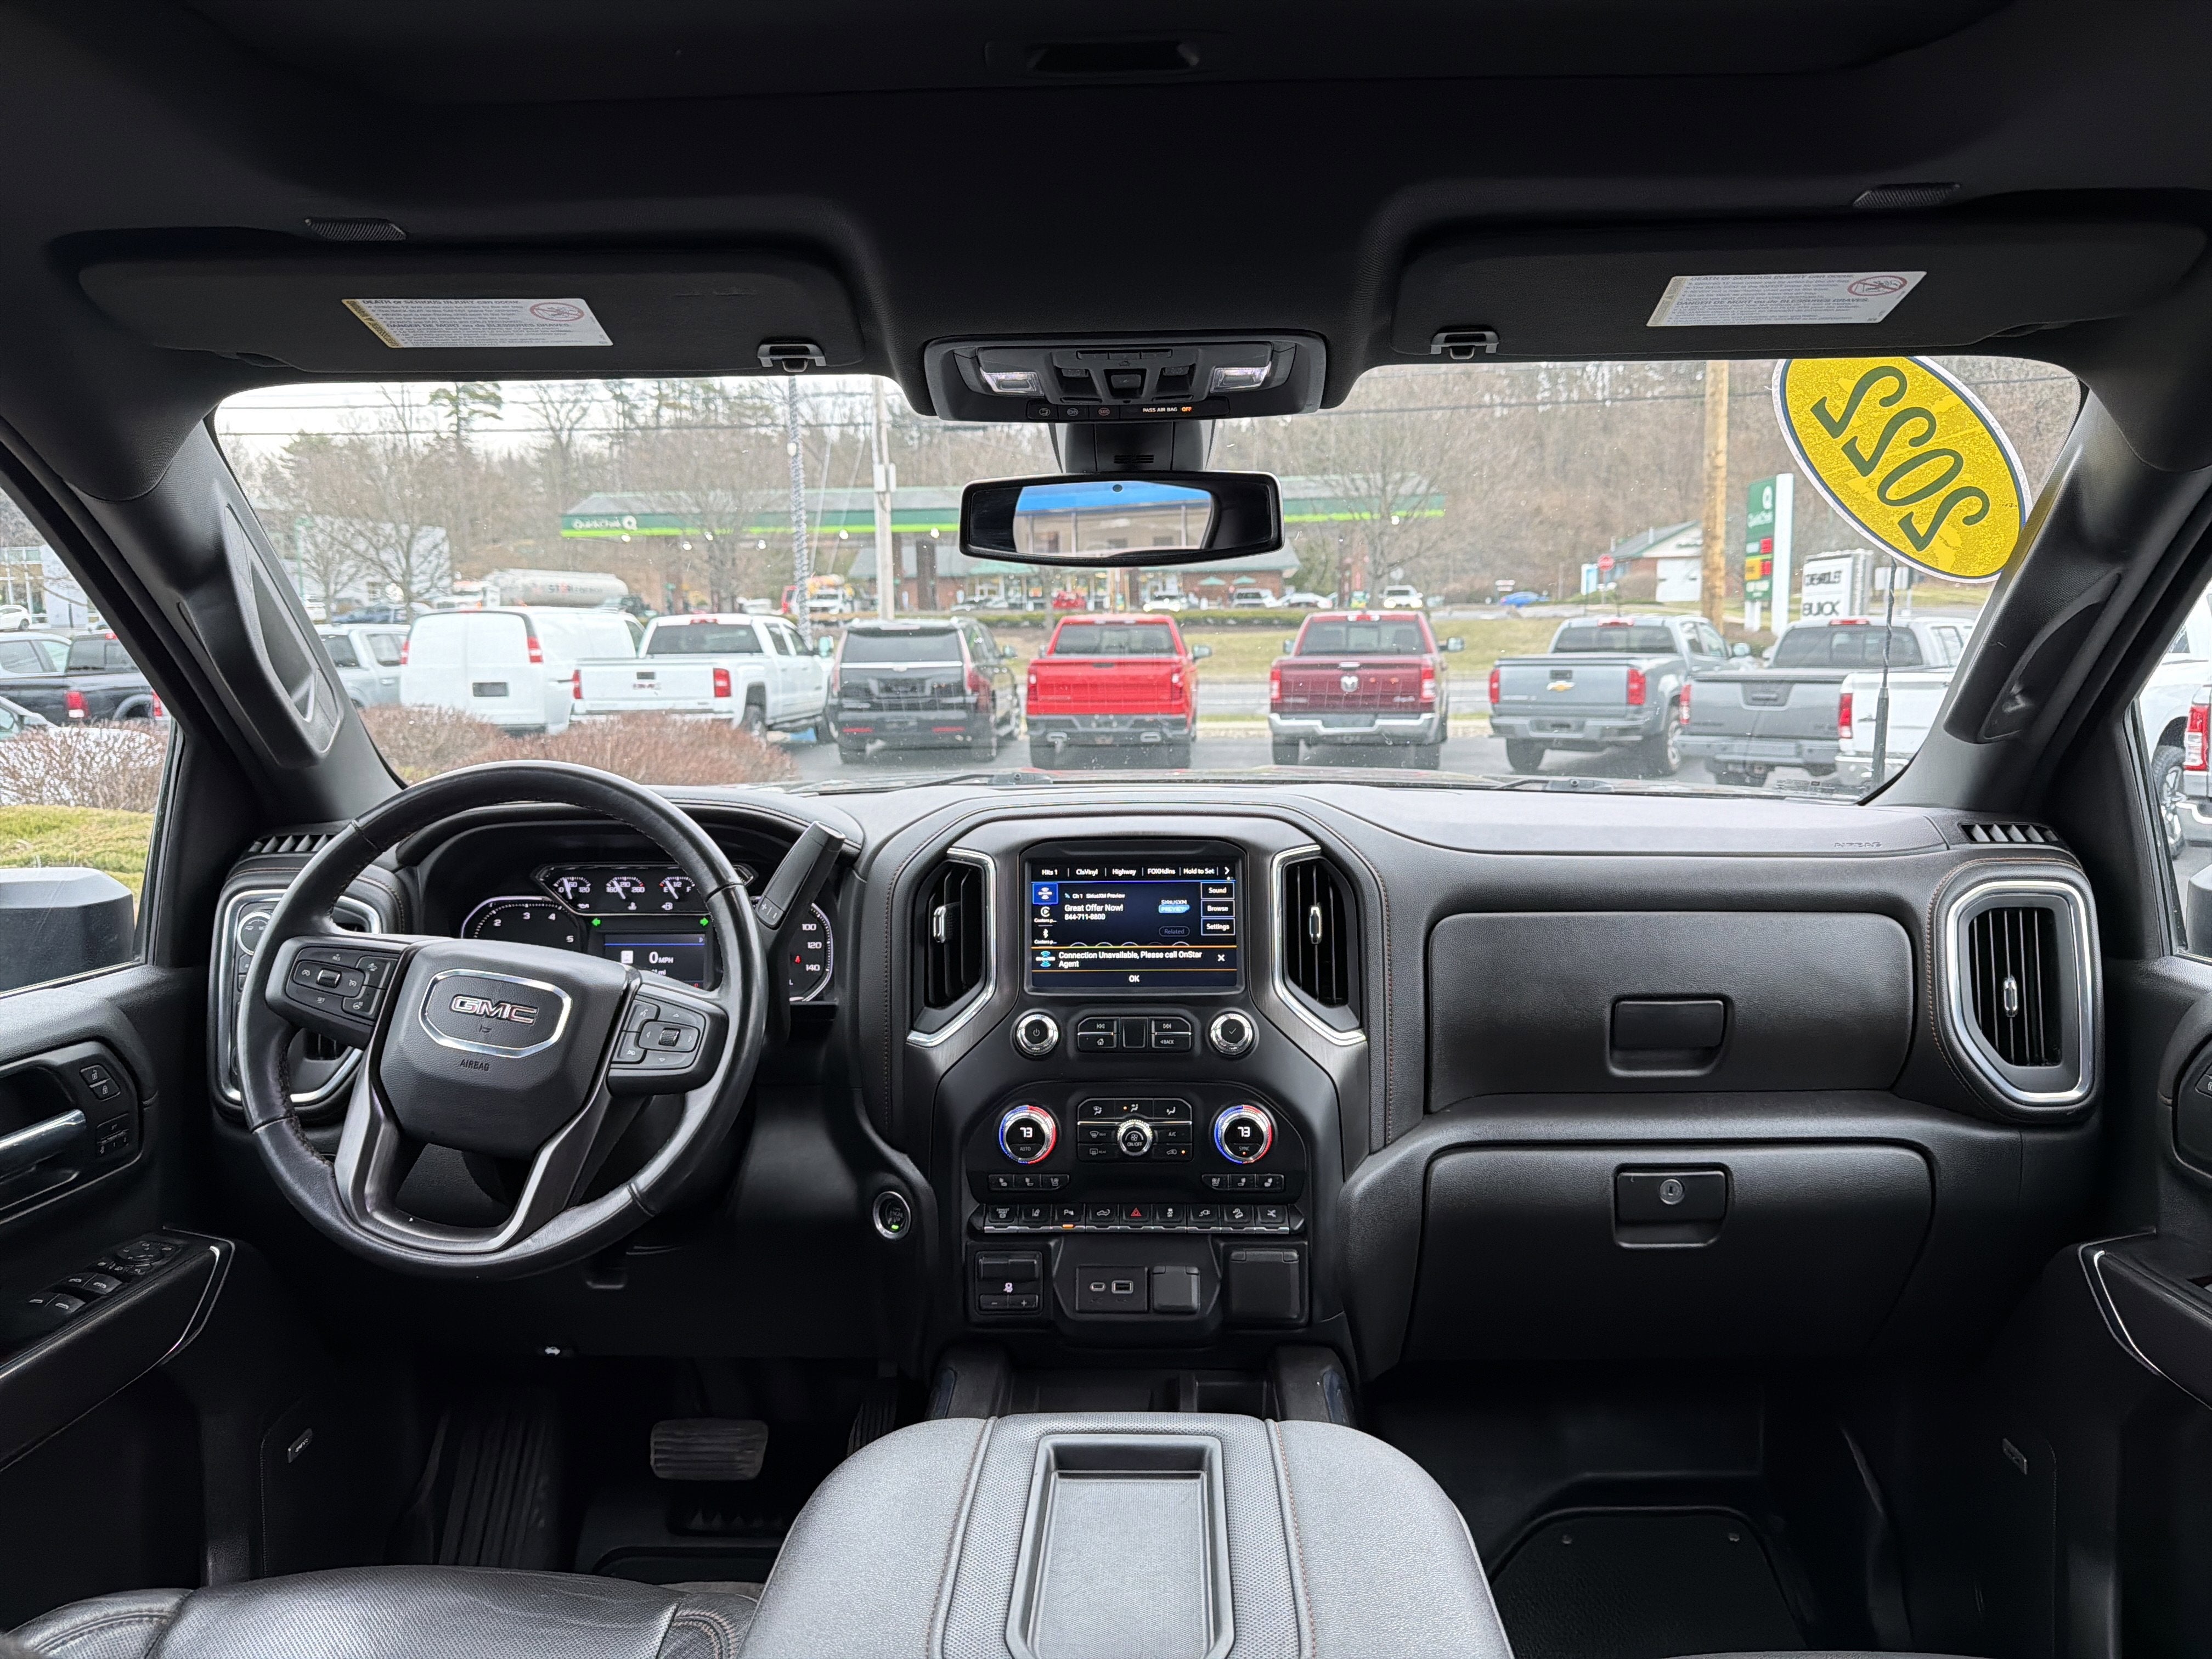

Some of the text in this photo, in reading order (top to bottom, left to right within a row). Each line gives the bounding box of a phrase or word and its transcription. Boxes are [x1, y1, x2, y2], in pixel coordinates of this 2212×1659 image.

[1206, 923, 1229, 931] Settings
[649, 951, 658, 964] 0
[1098, 951, 1139, 960] Unavailable,
[1058, 960, 1080, 969] Agent
[450, 994, 539, 1026] GMC
[460, 1058, 490, 1071] AIRBAG
[1020, 1126, 1032, 1138] 73
[1238, 1126, 1250, 1137] 73
